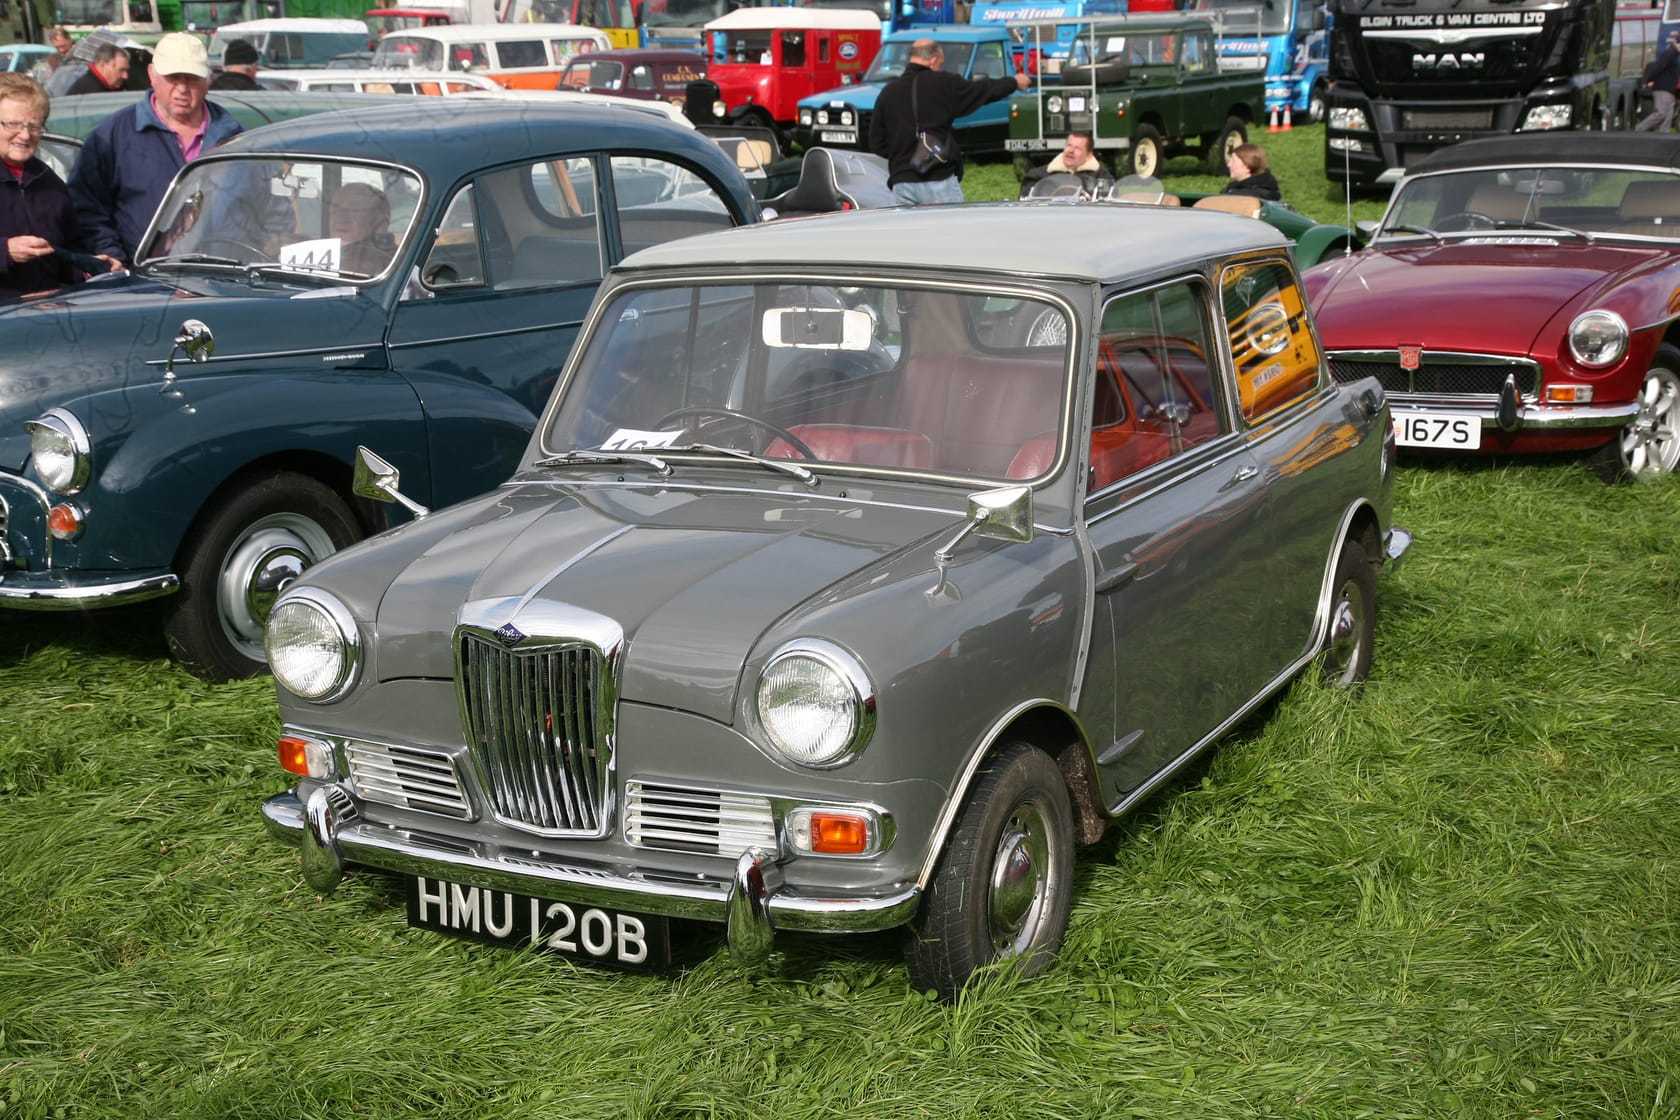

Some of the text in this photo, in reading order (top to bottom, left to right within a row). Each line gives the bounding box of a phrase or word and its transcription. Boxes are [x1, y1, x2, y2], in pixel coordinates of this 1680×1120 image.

[1360, 16, 1392, 27] ELGIN
[1395, 15, 1432, 26] TRUCK
[1447, 14, 1471, 24] VAN
[1474, 13, 1520, 24] CENTRE
[1523, 12, 1545, 23] LTD
[1412, 53, 1485, 69] MAN
[1404, 418, 1469, 443] 167S
[417, 876, 648, 963] HMU 120B
